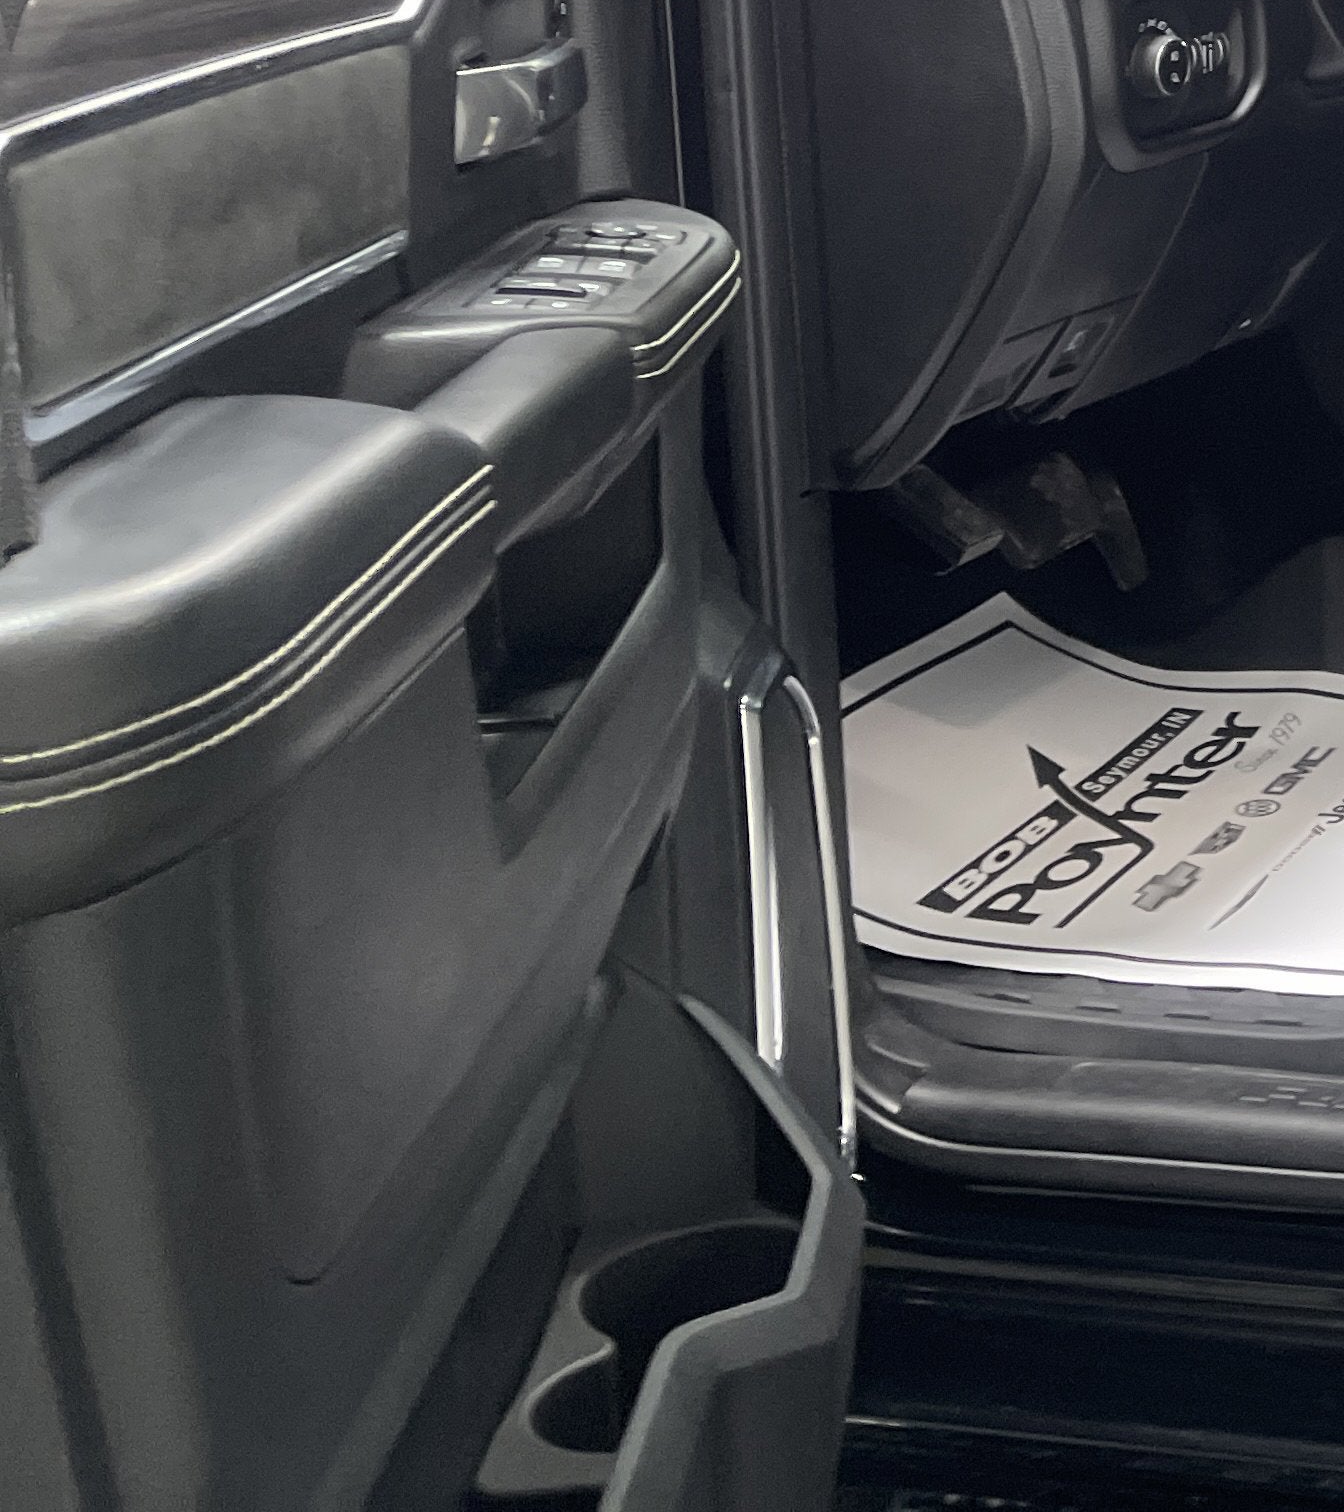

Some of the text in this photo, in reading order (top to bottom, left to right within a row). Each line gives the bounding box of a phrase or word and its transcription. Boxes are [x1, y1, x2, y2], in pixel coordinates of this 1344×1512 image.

[1081, 710, 1193, 794] Seymour, IN
[1268, 712, 1302, 746] 1979
[1261, 746, 1339, 796] GMC
[942, 815, 1061, 902] BOB
